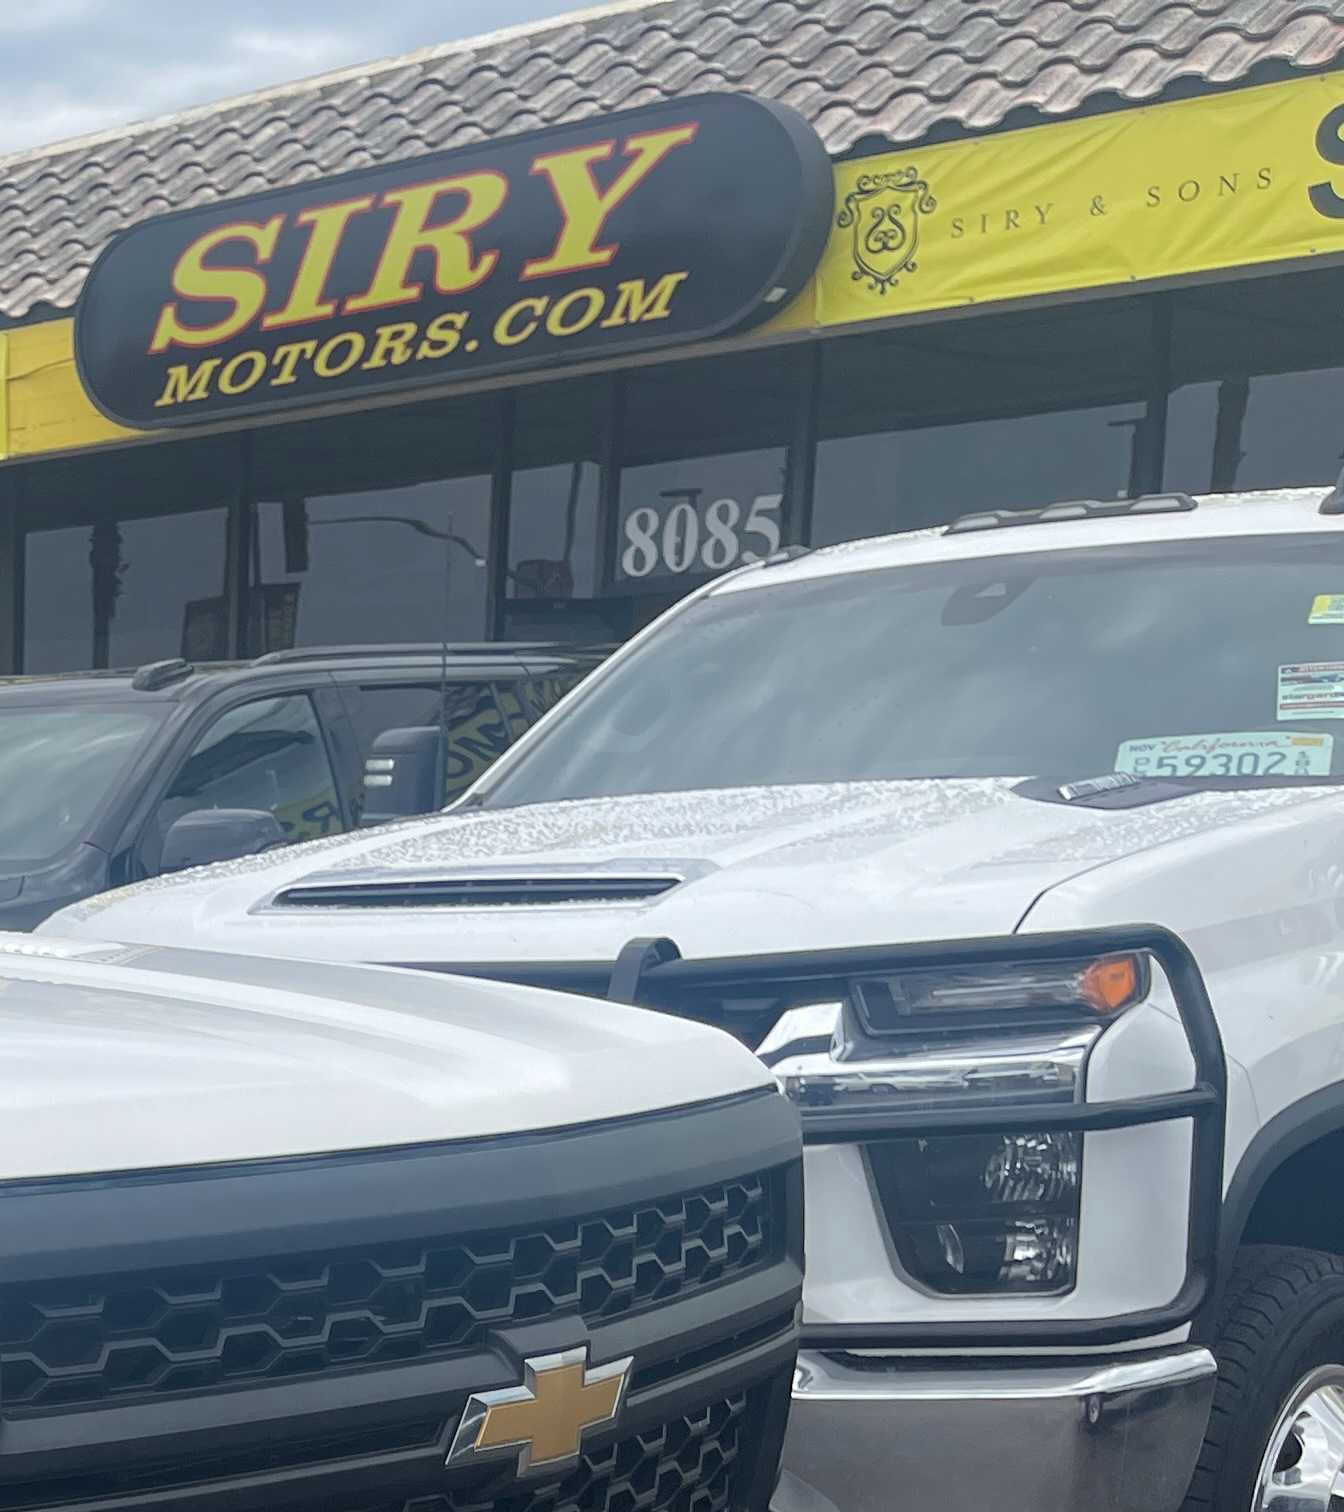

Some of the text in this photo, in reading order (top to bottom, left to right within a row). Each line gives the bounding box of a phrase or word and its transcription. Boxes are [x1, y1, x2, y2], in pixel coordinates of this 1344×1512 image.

[147, 121, 700, 354] SIRY
[949, 167, 1274, 241] SIRY & SONS
[153, 270, 689, 408] MOTORS.COM
[621, 493, 784, 577] 8085
